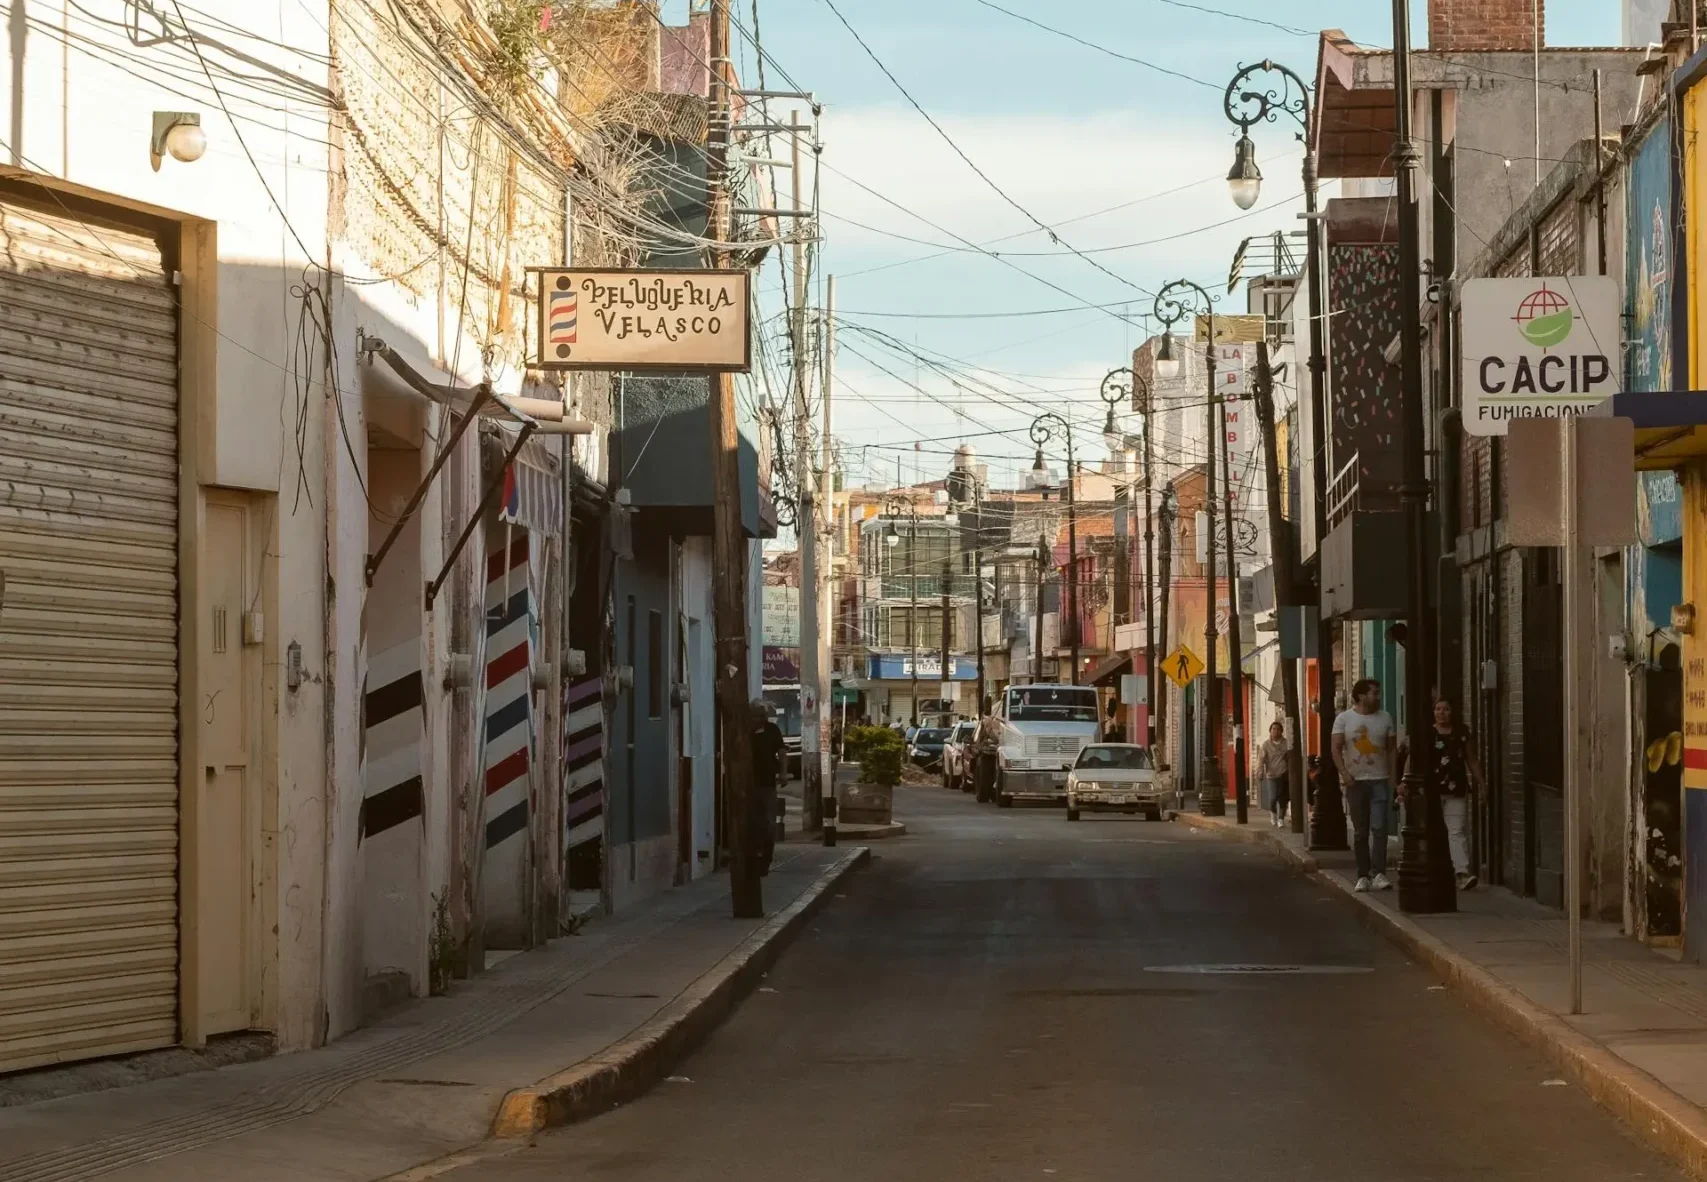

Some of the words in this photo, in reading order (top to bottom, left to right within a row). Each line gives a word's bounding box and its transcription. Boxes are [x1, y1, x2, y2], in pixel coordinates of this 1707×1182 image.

[594, 308, 721, 342] VELASCO
[1222, 349, 1241, 360] LA
[1479, 355, 1609, 394] CACIP
[1224, 373, 1242, 501] BOMBILA
